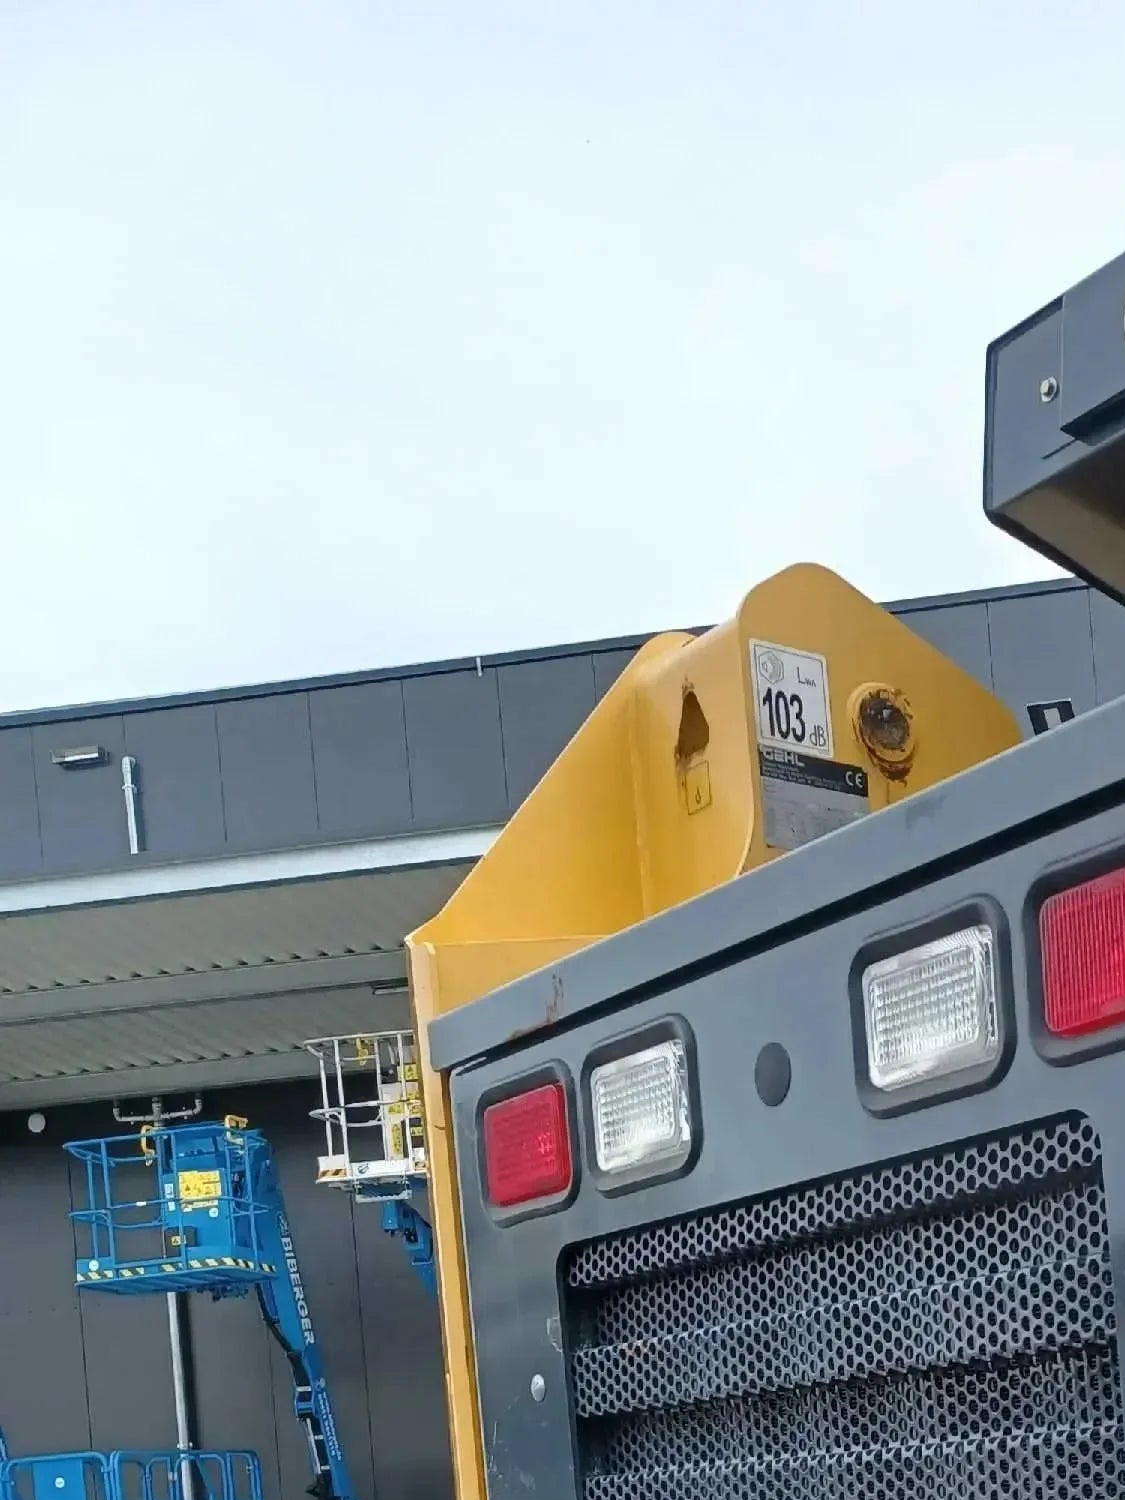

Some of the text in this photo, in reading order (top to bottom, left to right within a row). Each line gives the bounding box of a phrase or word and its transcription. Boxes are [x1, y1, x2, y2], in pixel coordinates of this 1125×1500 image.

[763, 687, 826, 747] 103 dB
[281, 1237, 315, 1346] BIBERGER
